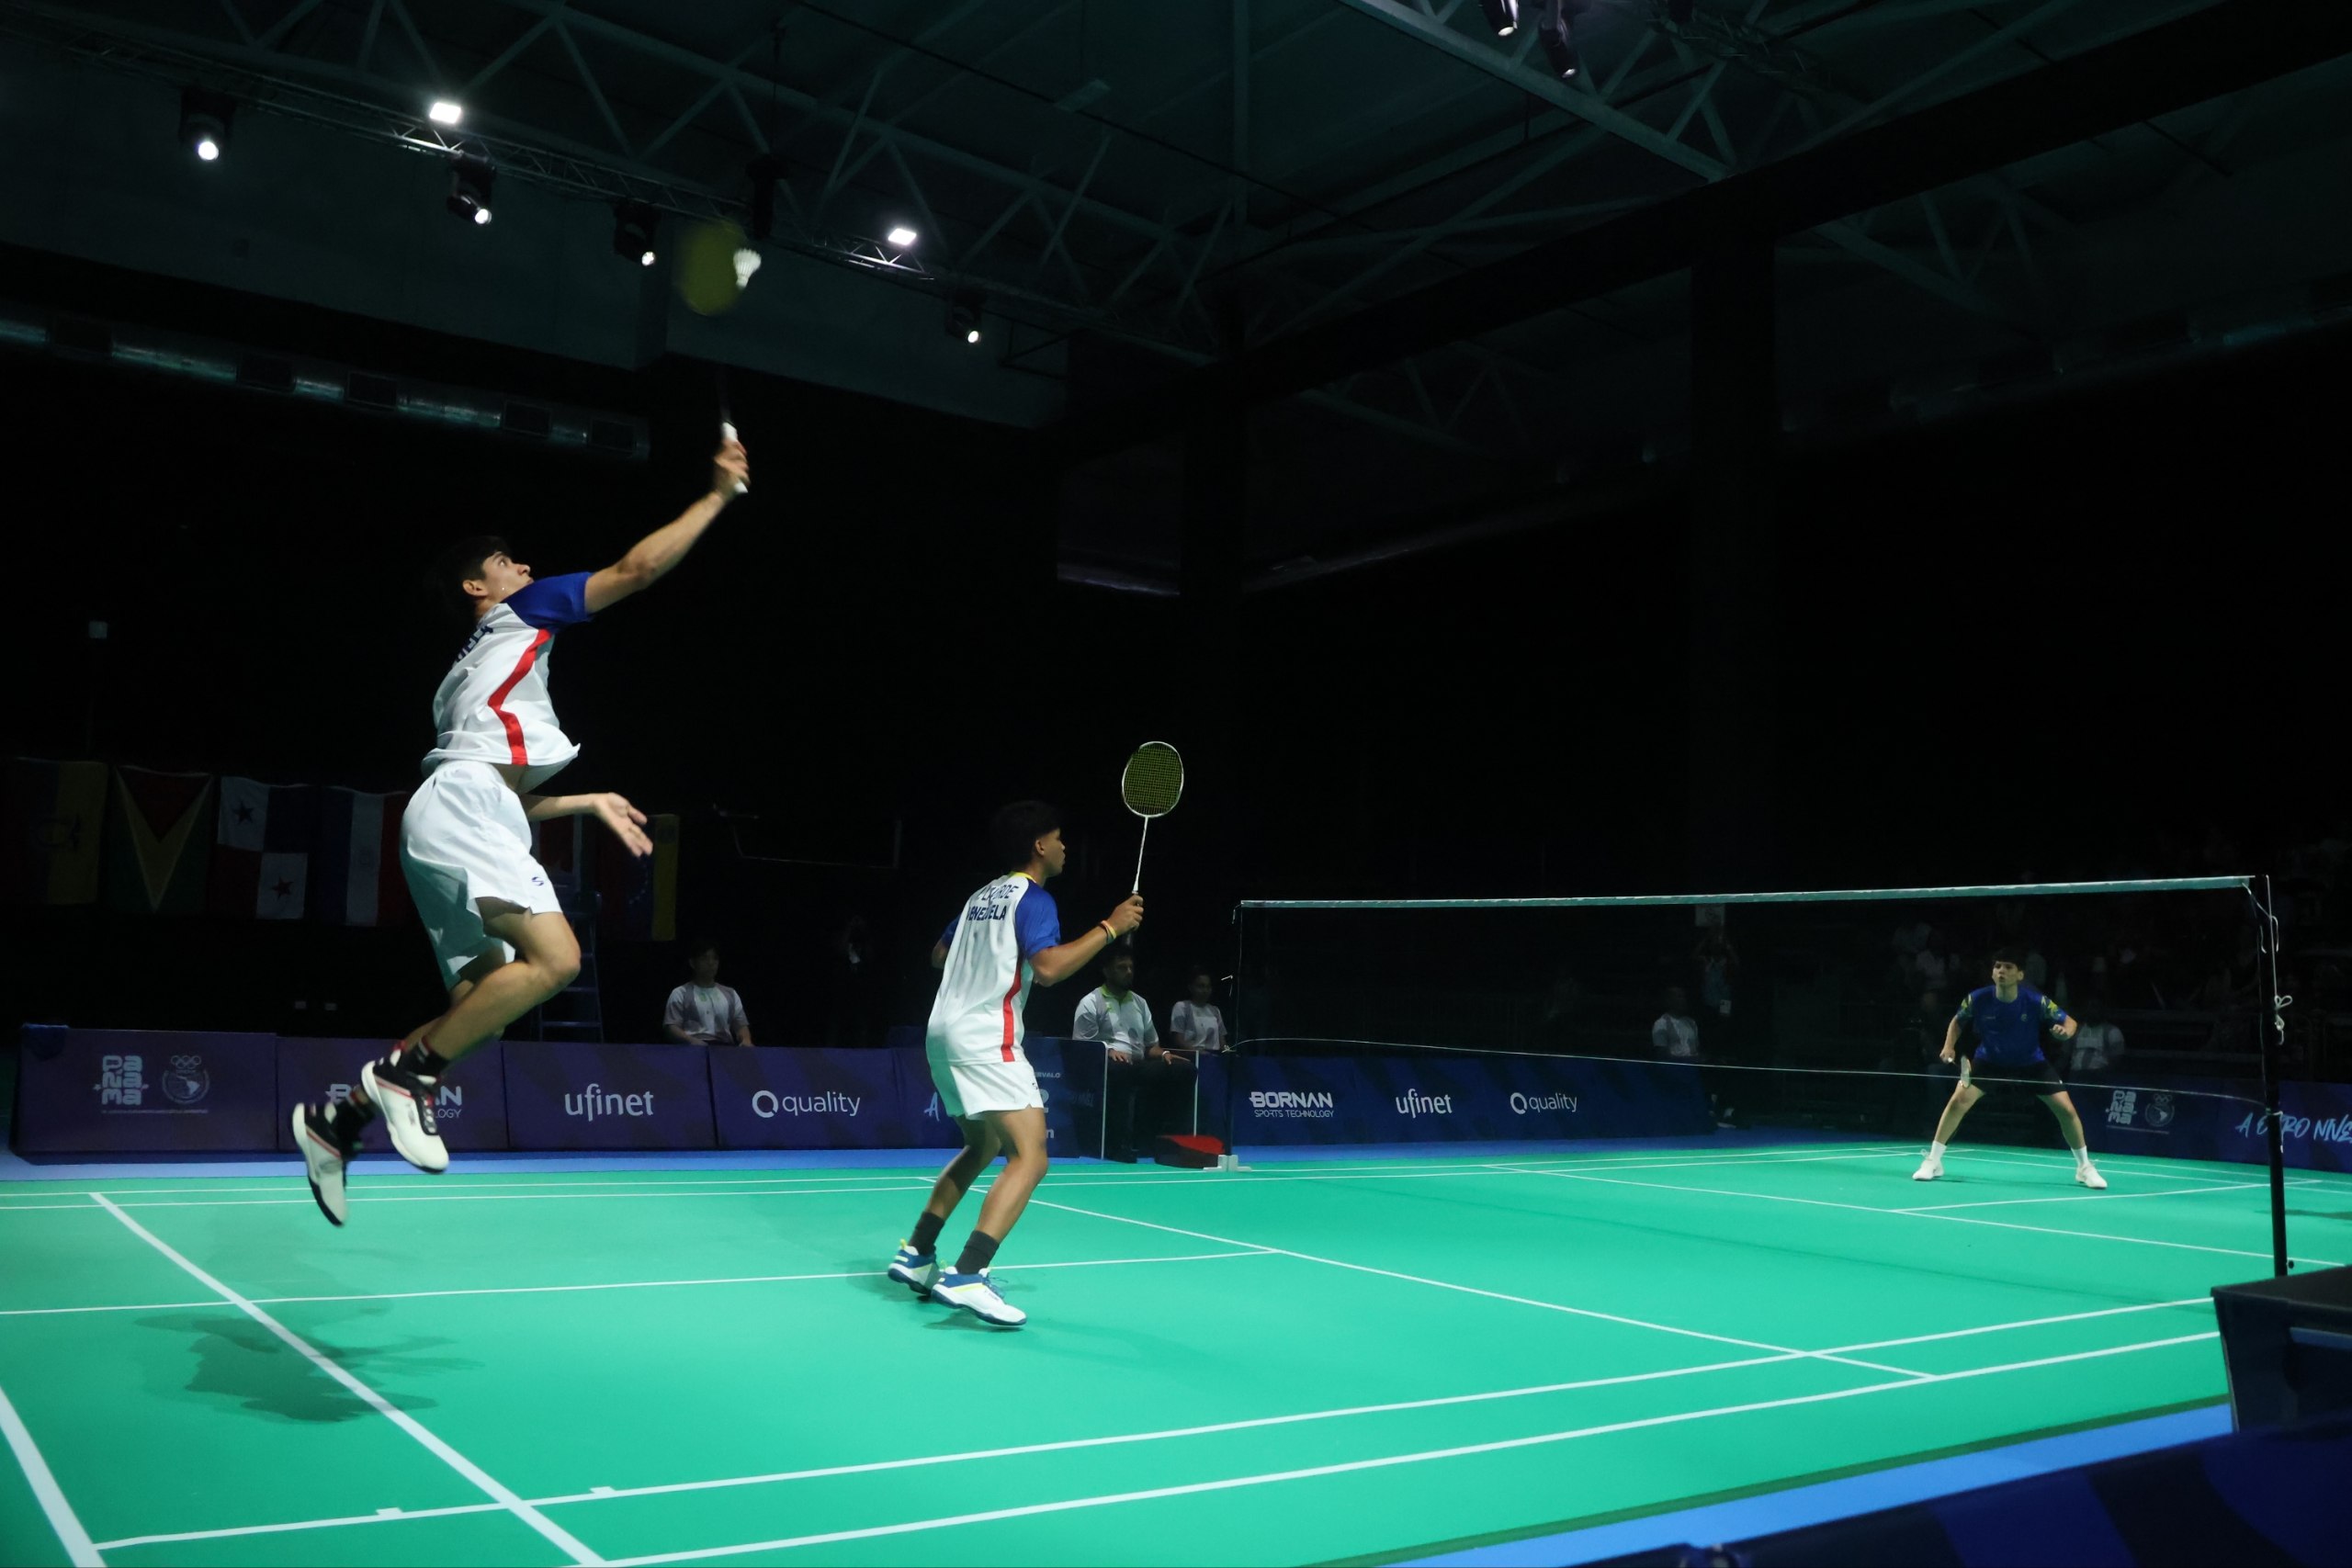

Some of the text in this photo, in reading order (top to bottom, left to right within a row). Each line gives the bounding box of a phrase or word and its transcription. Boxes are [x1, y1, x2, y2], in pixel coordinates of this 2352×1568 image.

[564, 1083, 654, 1122] ufinet
[782, 1091, 861, 1117] quality
[1249, 1091, 1333, 1109] BORNAN
[1396, 1088, 1453, 1119] ufinet
[1529, 1089, 1577, 1113] quality
[1254, 1110, 1334, 1118] SPORTS TECHNOLOGY
[2235, 1112, 2254, 1138] A
[2256, 1114, 2311, 1138] ORO
